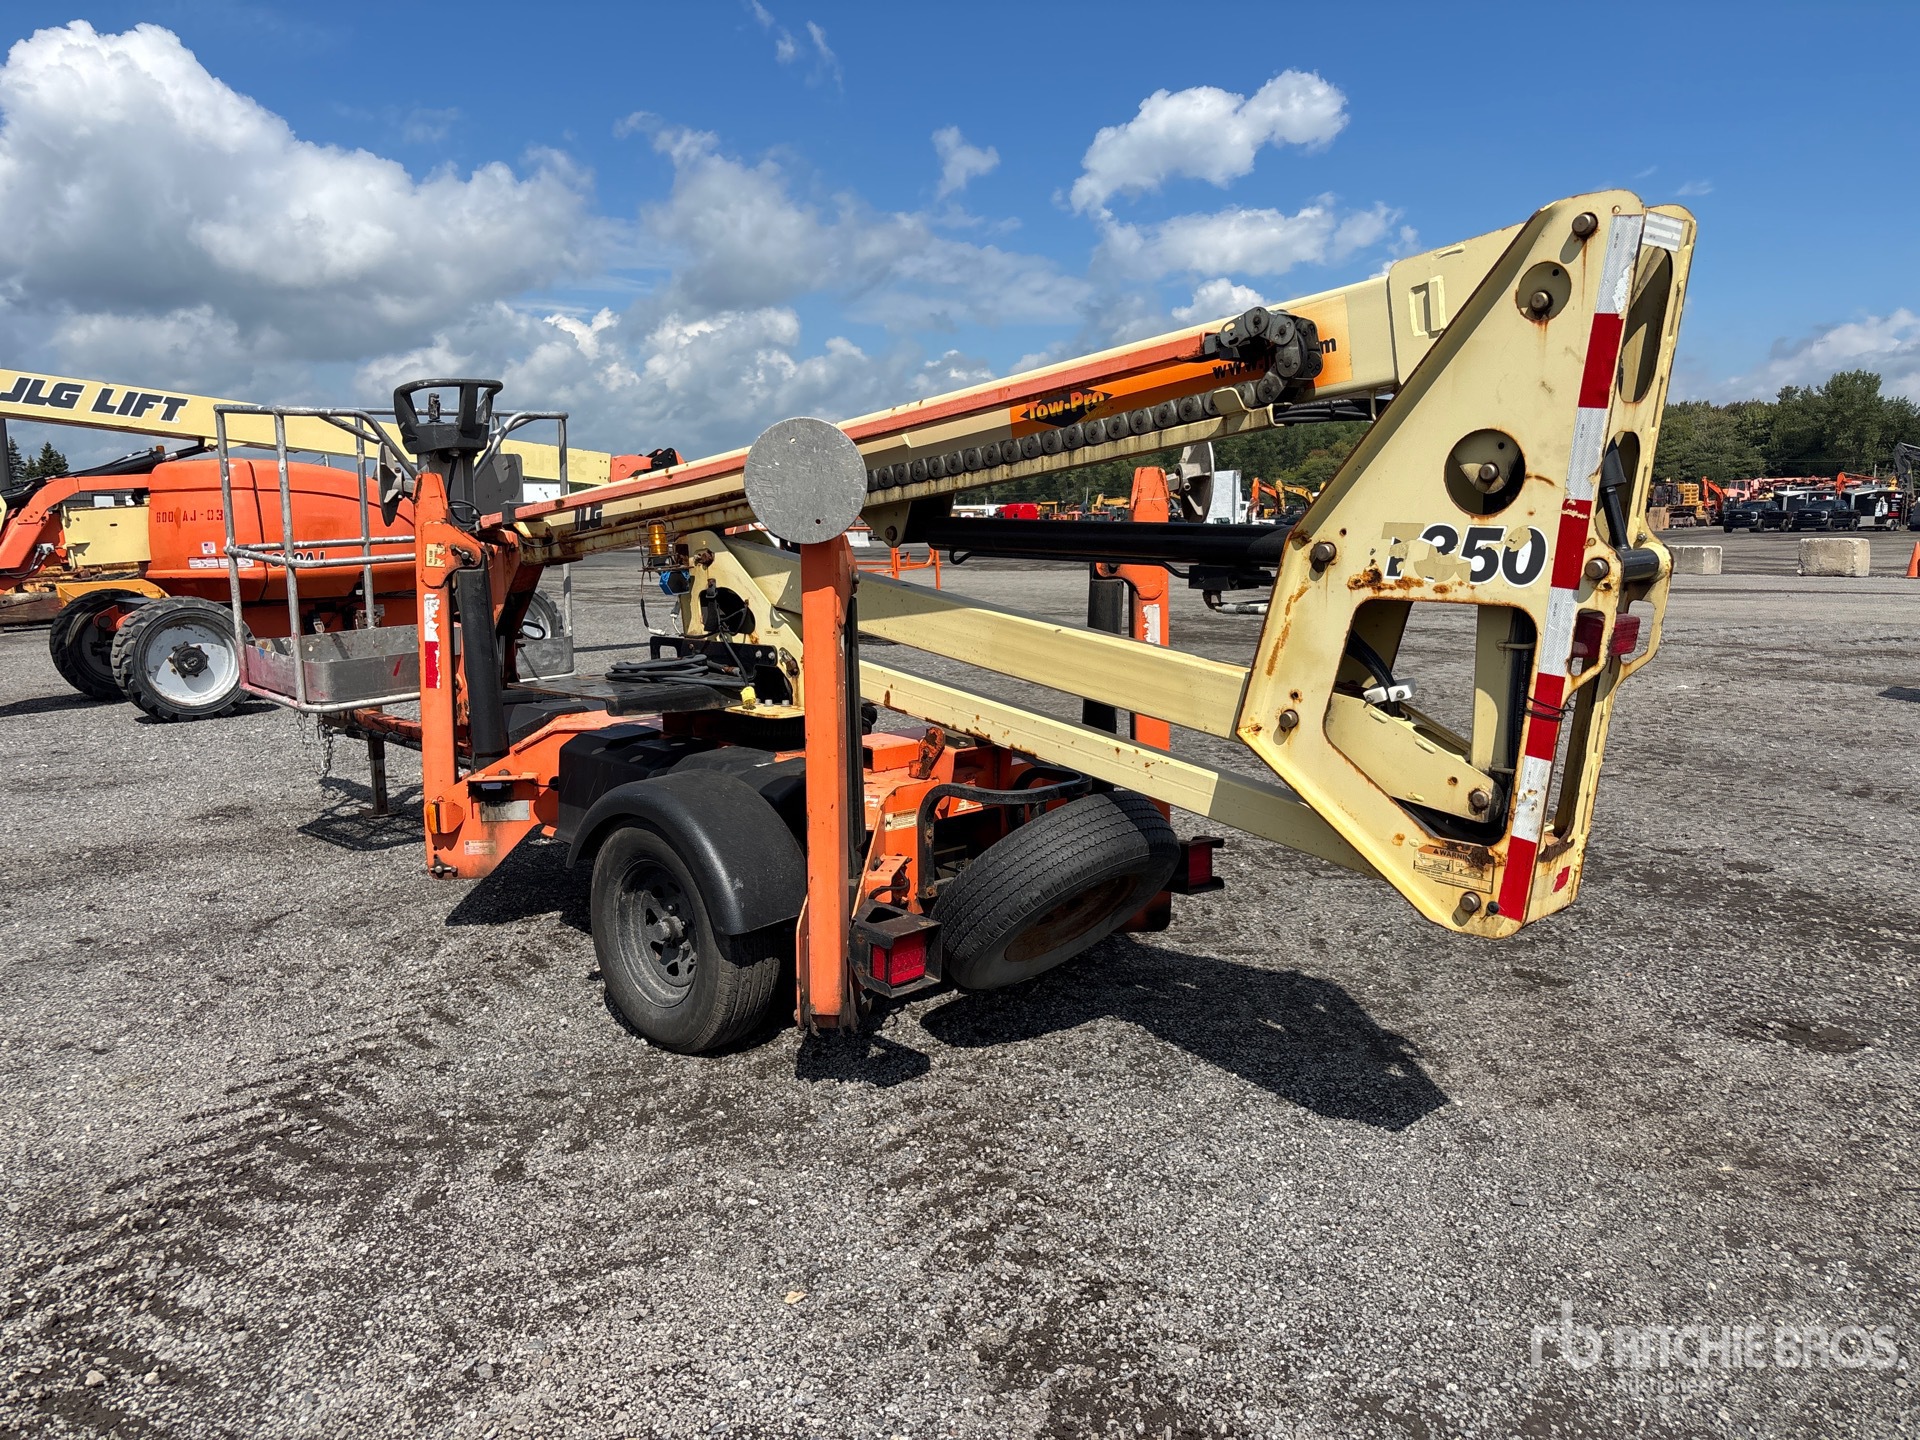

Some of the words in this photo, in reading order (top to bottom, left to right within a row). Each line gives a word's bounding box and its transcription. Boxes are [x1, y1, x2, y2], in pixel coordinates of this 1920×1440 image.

[0, 377, 85, 410] JLG
[91, 388, 188, 422] LIFT
[156, 511, 174, 523] 600
[1439, 848, 1469, 860] WARNI
